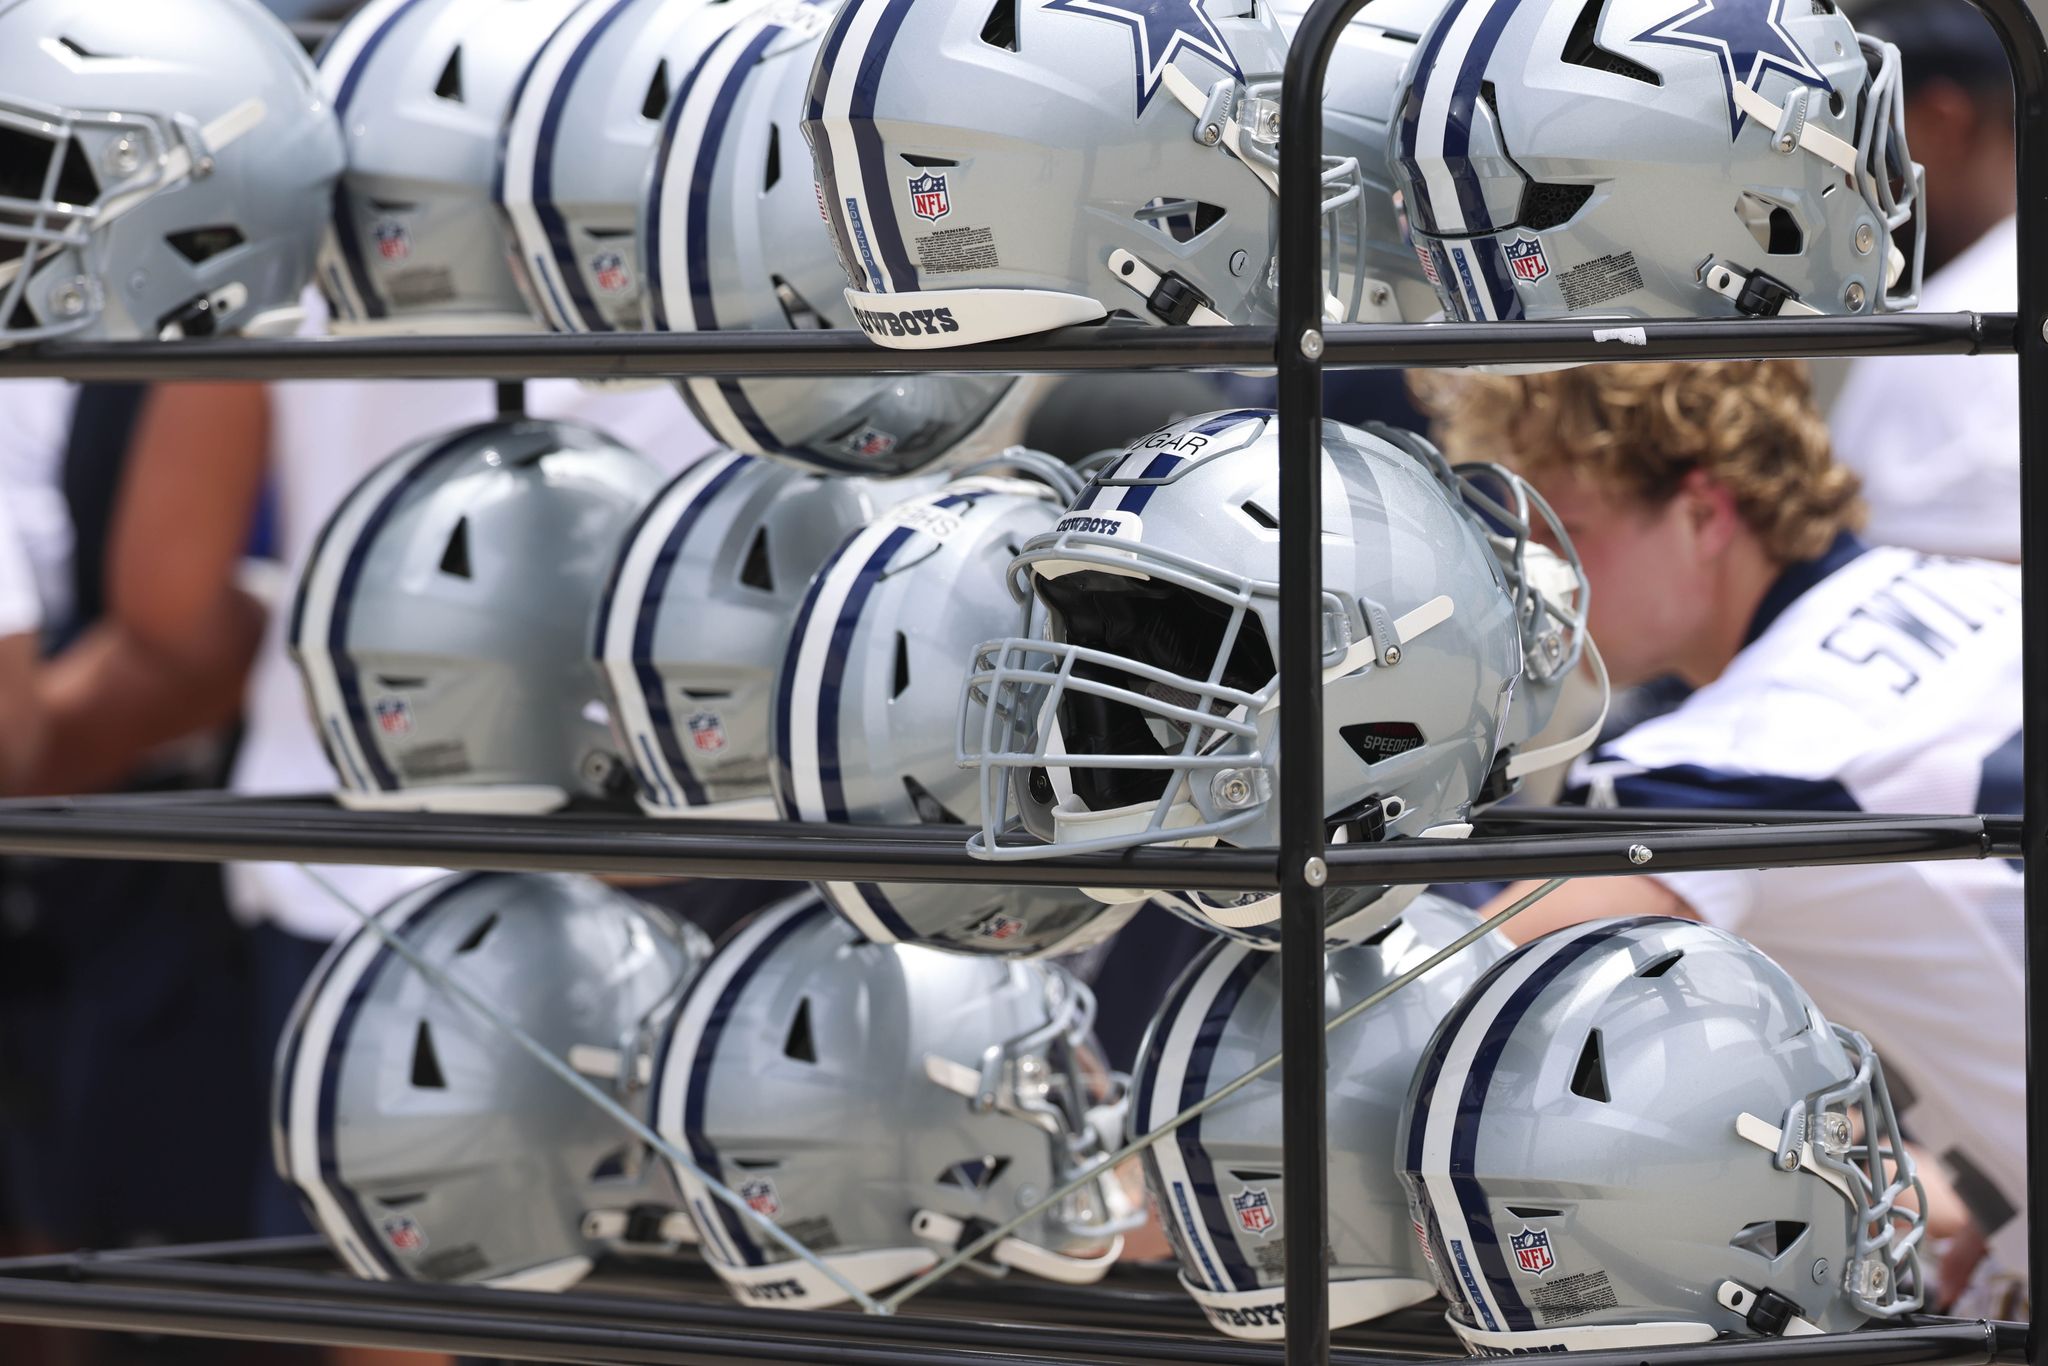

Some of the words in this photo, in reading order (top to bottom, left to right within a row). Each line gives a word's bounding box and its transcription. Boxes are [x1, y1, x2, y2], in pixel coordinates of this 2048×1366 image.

[914, 193, 947, 216] NFL
[848, 200, 873, 267] JOHNSON
[931, 226, 971, 236] WARNING
[1512, 254, 1546, 279] NFL
[1572, 254, 1612, 270] WARNING
[1240, 1207, 1272, 1229] NFL
[1517, 1247, 1551, 1270] NFL
[1452, 1242, 1482, 1304] GILLIAM
[1545, 1272, 1586, 1286] WARNING
